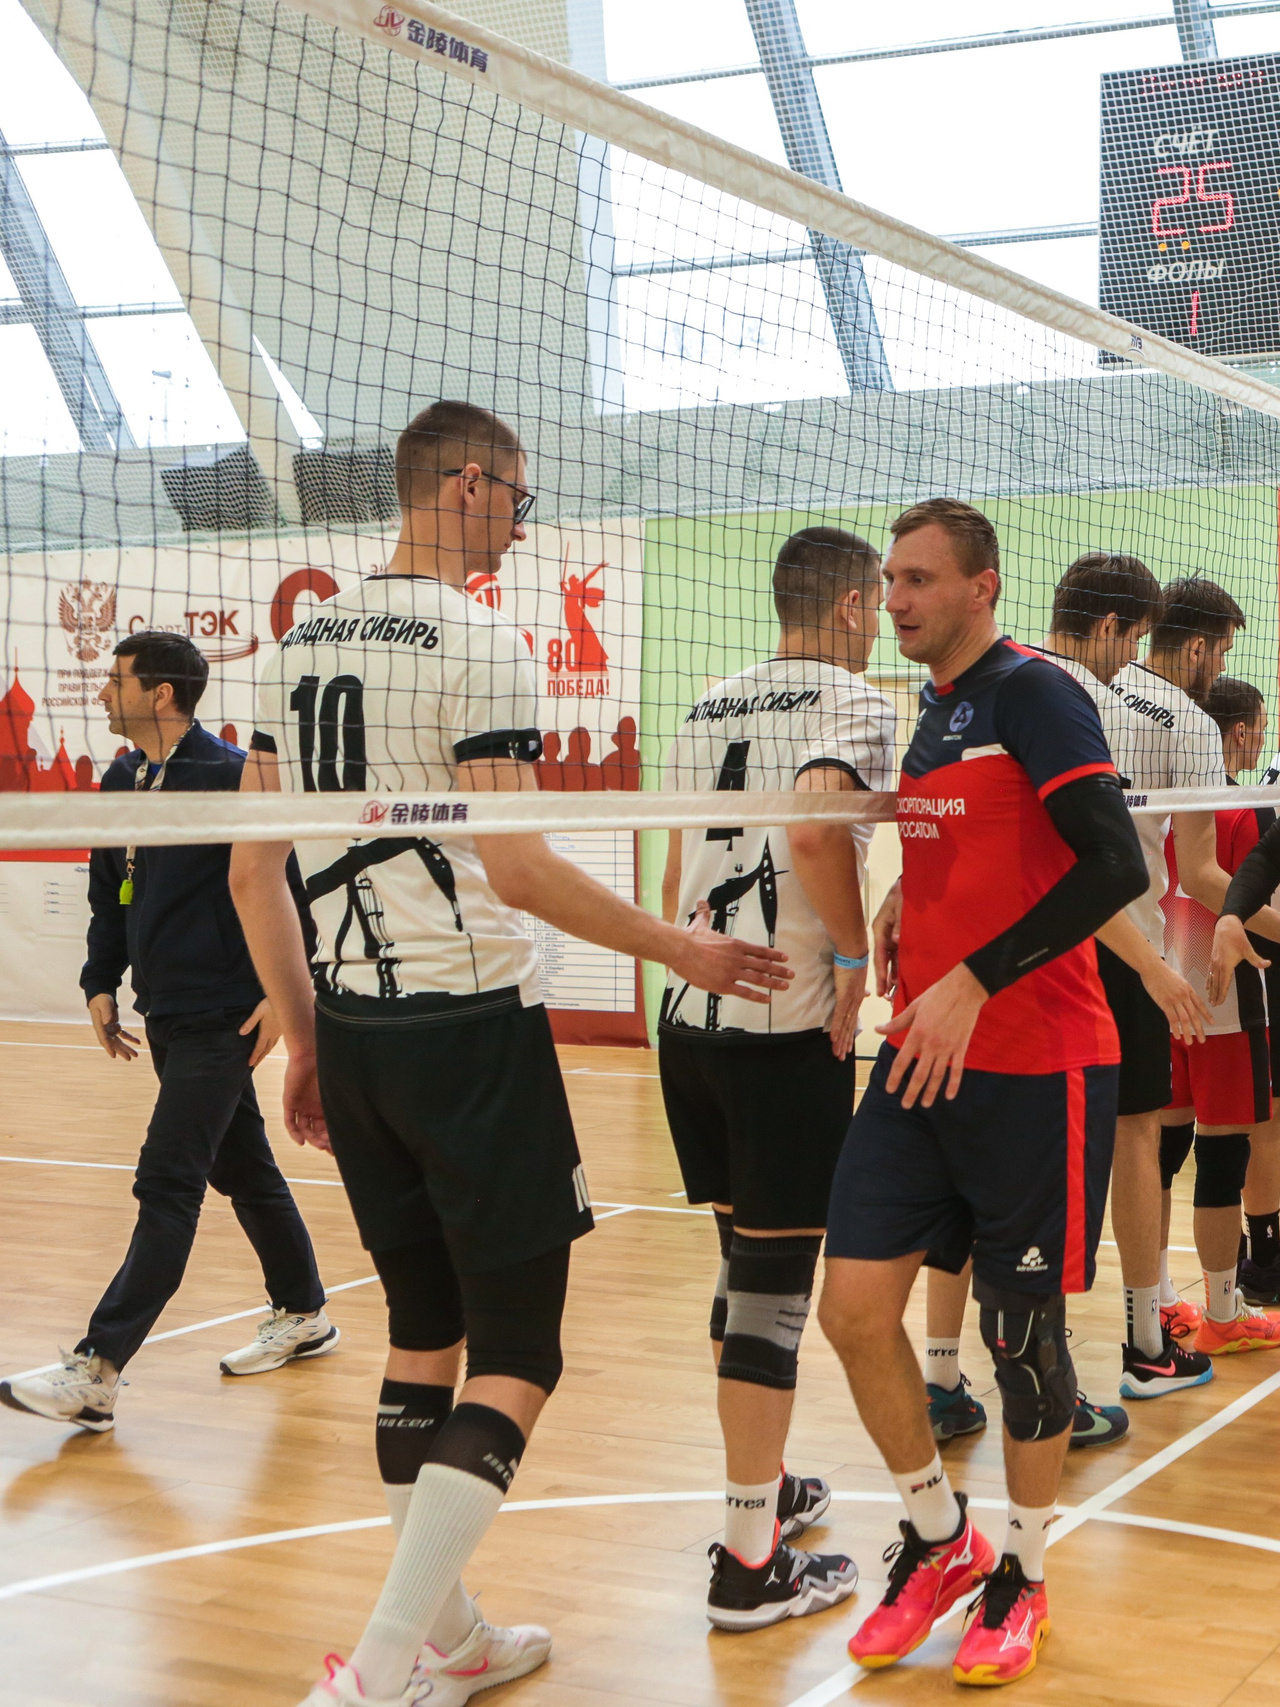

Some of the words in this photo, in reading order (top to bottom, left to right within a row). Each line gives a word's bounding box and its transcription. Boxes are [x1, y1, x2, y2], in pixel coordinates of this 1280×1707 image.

[407, 19, 489, 73] 金陵体育
[1152, 161, 1234, 236] 25
[1147, 258, 1225, 283] ФОЛЫ
[1190, 290, 1200, 337] 1
[282, 617, 361, 650] АПАДНАЯ
[360, 615, 440, 650] СИБИРЬ
[547, 678, 610, 696] ПОБЕДА!
[1123, 694, 1175, 729] СИБИРЬ
[290, 674, 367, 792] 10
[391, 803, 469, 825] 金陵体育
